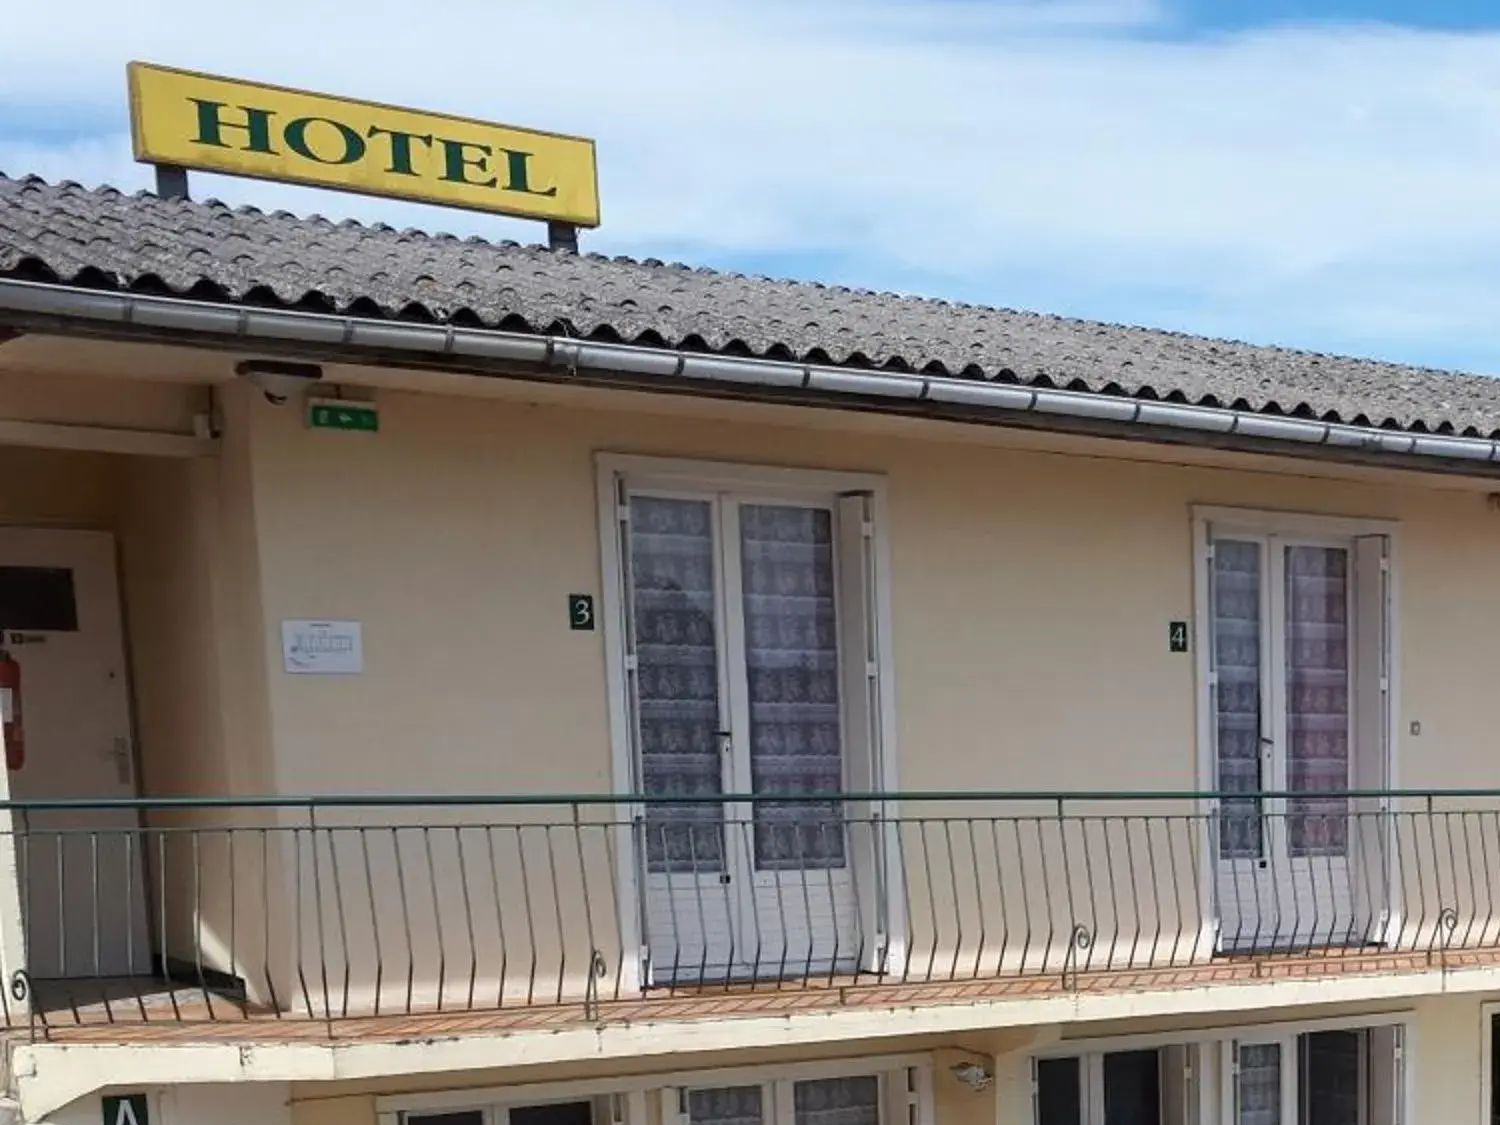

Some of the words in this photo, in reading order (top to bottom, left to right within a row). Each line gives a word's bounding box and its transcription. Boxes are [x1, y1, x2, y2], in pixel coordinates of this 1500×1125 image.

[186, 97, 557, 197] HOTEL
[575, 599, 590, 625] 3
[1171, 627, 1184, 648] 4
